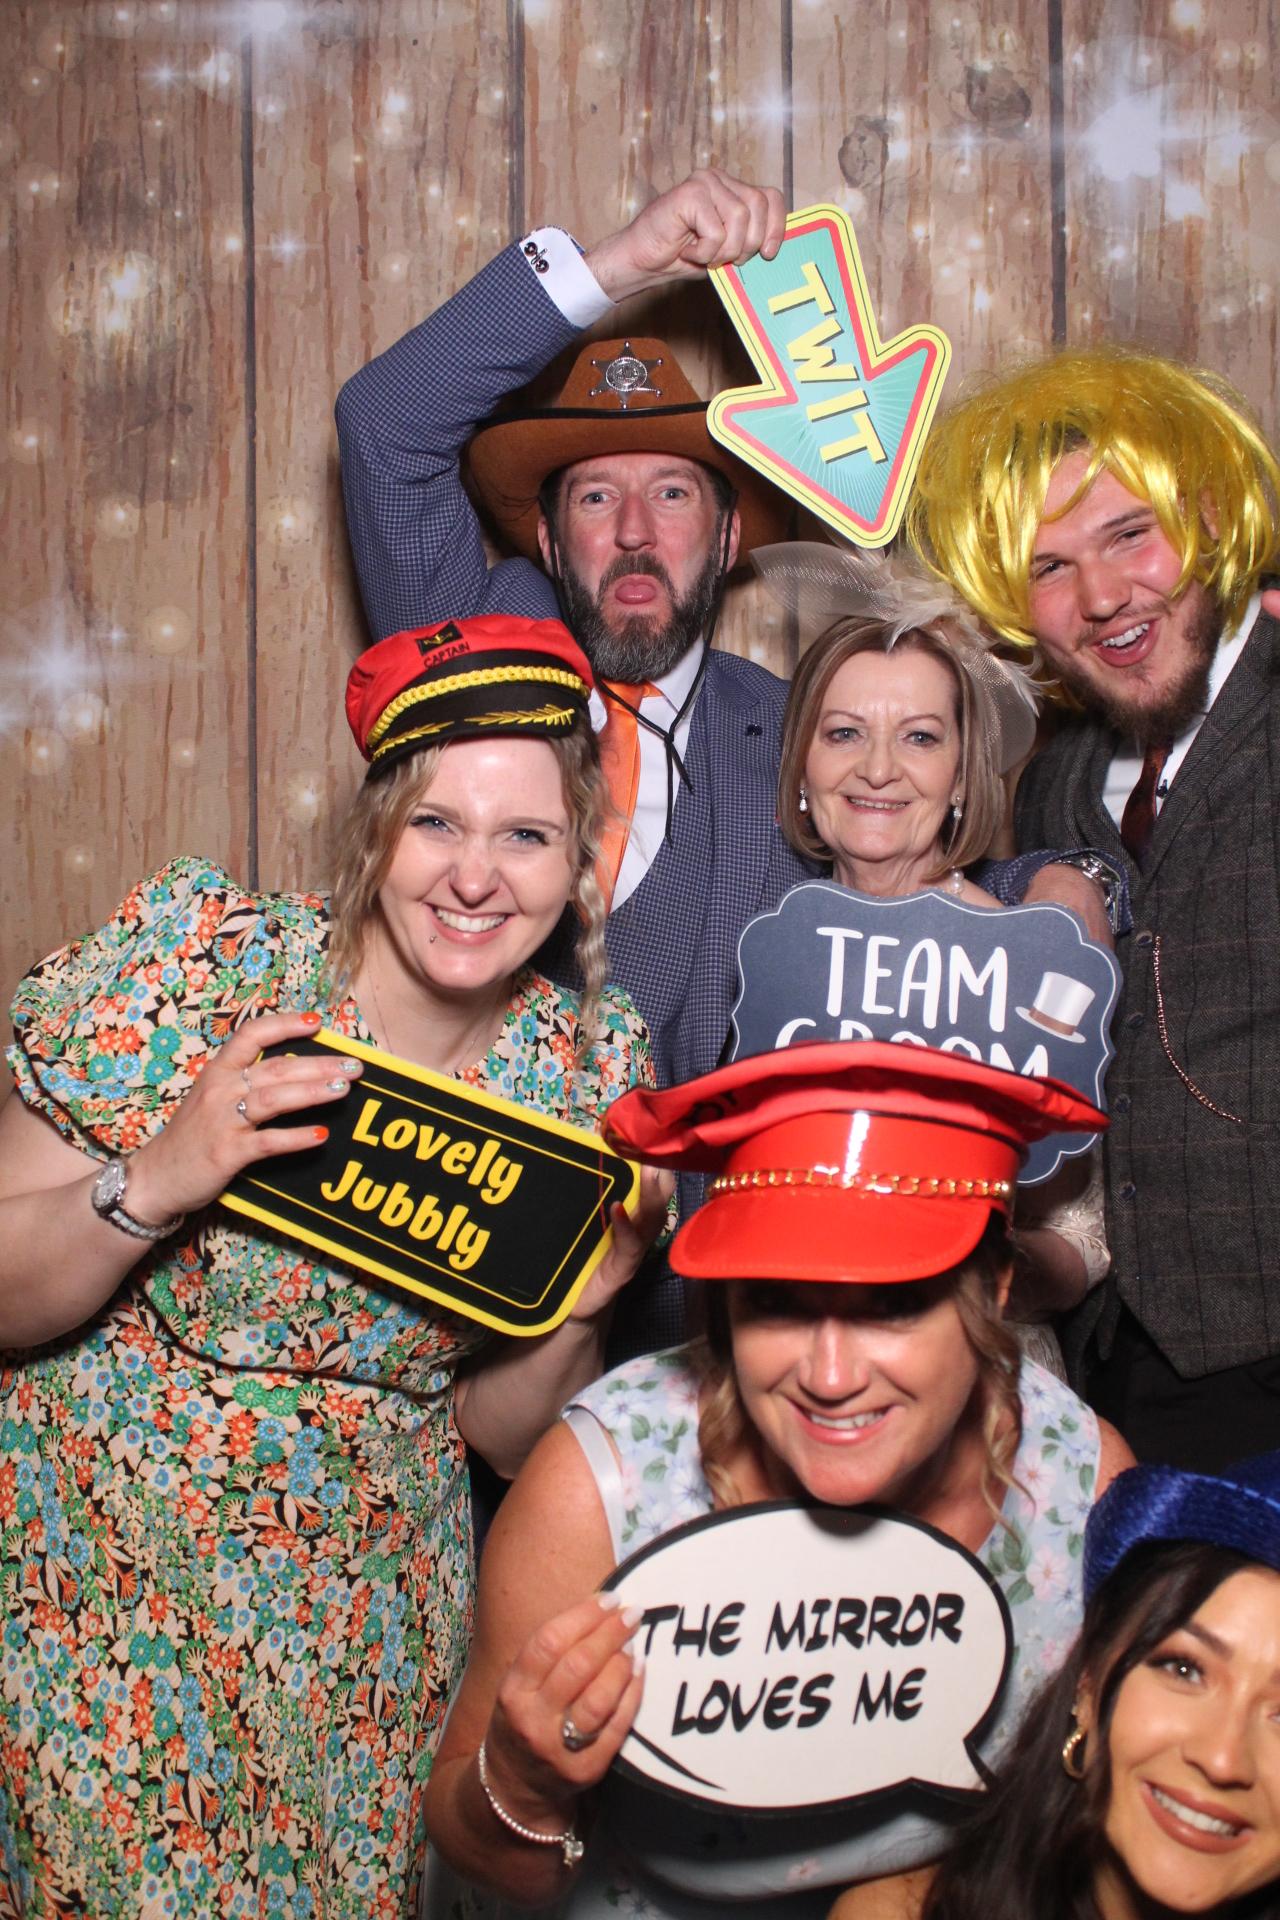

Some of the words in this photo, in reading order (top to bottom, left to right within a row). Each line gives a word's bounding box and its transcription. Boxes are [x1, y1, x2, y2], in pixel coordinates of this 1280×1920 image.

[767, 262, 889, 464] TWIT
[423, 641, 470, 669] CAPTAIN
[816, 927, 1008, 1033] TEAM
[352, 1098, 524, 1205] Lovely
[320, 1160, 491, 1271] Jubbly
[640, 1601, 746, 1658] THE
[765, 1593, 965, 1655] MIRROR
[671, 1673, 834, 1737] LOVES
[853, 1667, 927, 1725] ME
